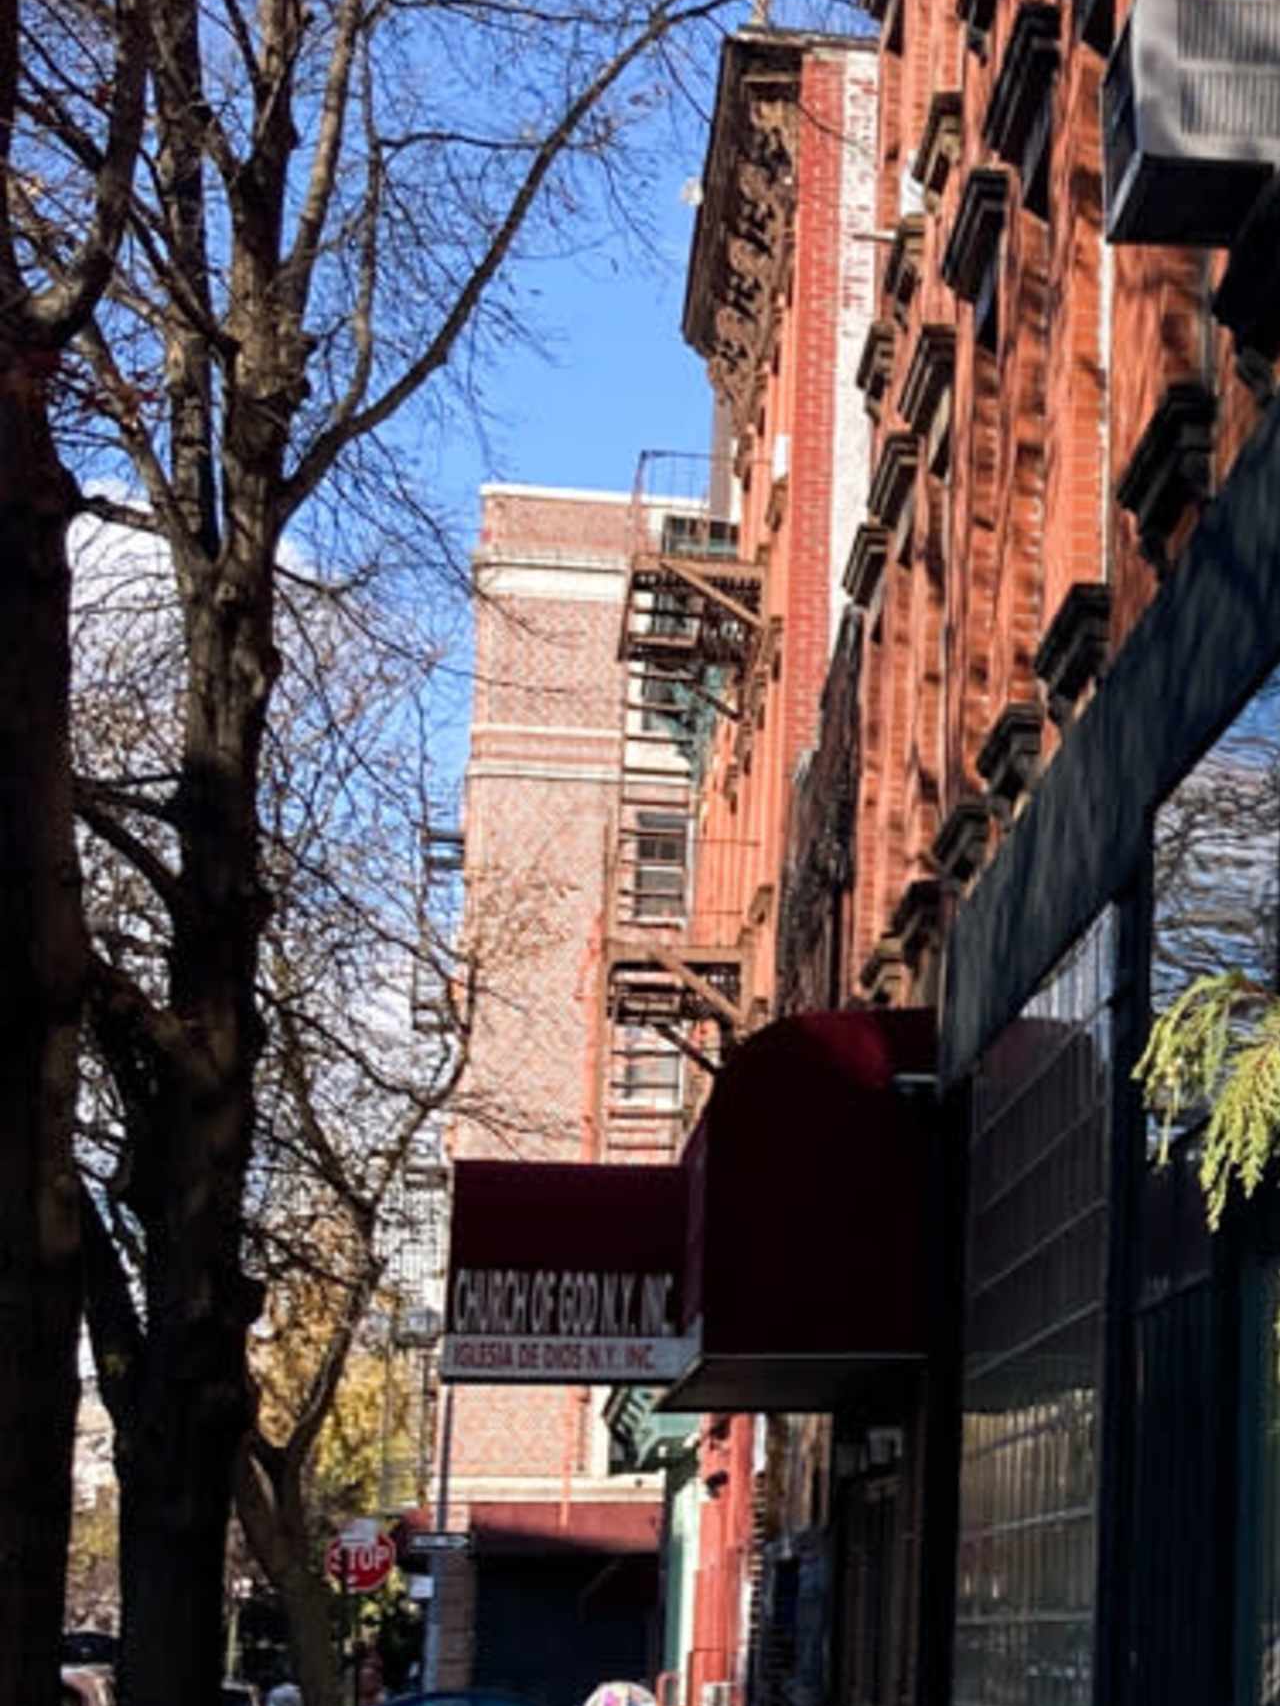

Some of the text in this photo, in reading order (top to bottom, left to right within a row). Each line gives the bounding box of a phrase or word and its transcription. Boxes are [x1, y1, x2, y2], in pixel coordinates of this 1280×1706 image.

[454, 1268, 529, 1334] CHURCH
[531, 1269, 558, 1334] OF
[558, 1270, 599, 1335] GOD
[454, 1343, 513, 1368] IGLESIA
[518, 1343, 540, 1369] DE
[543, 1343, 581, 1370] DIOS
[328, 1544, 390, 1572] STOP
